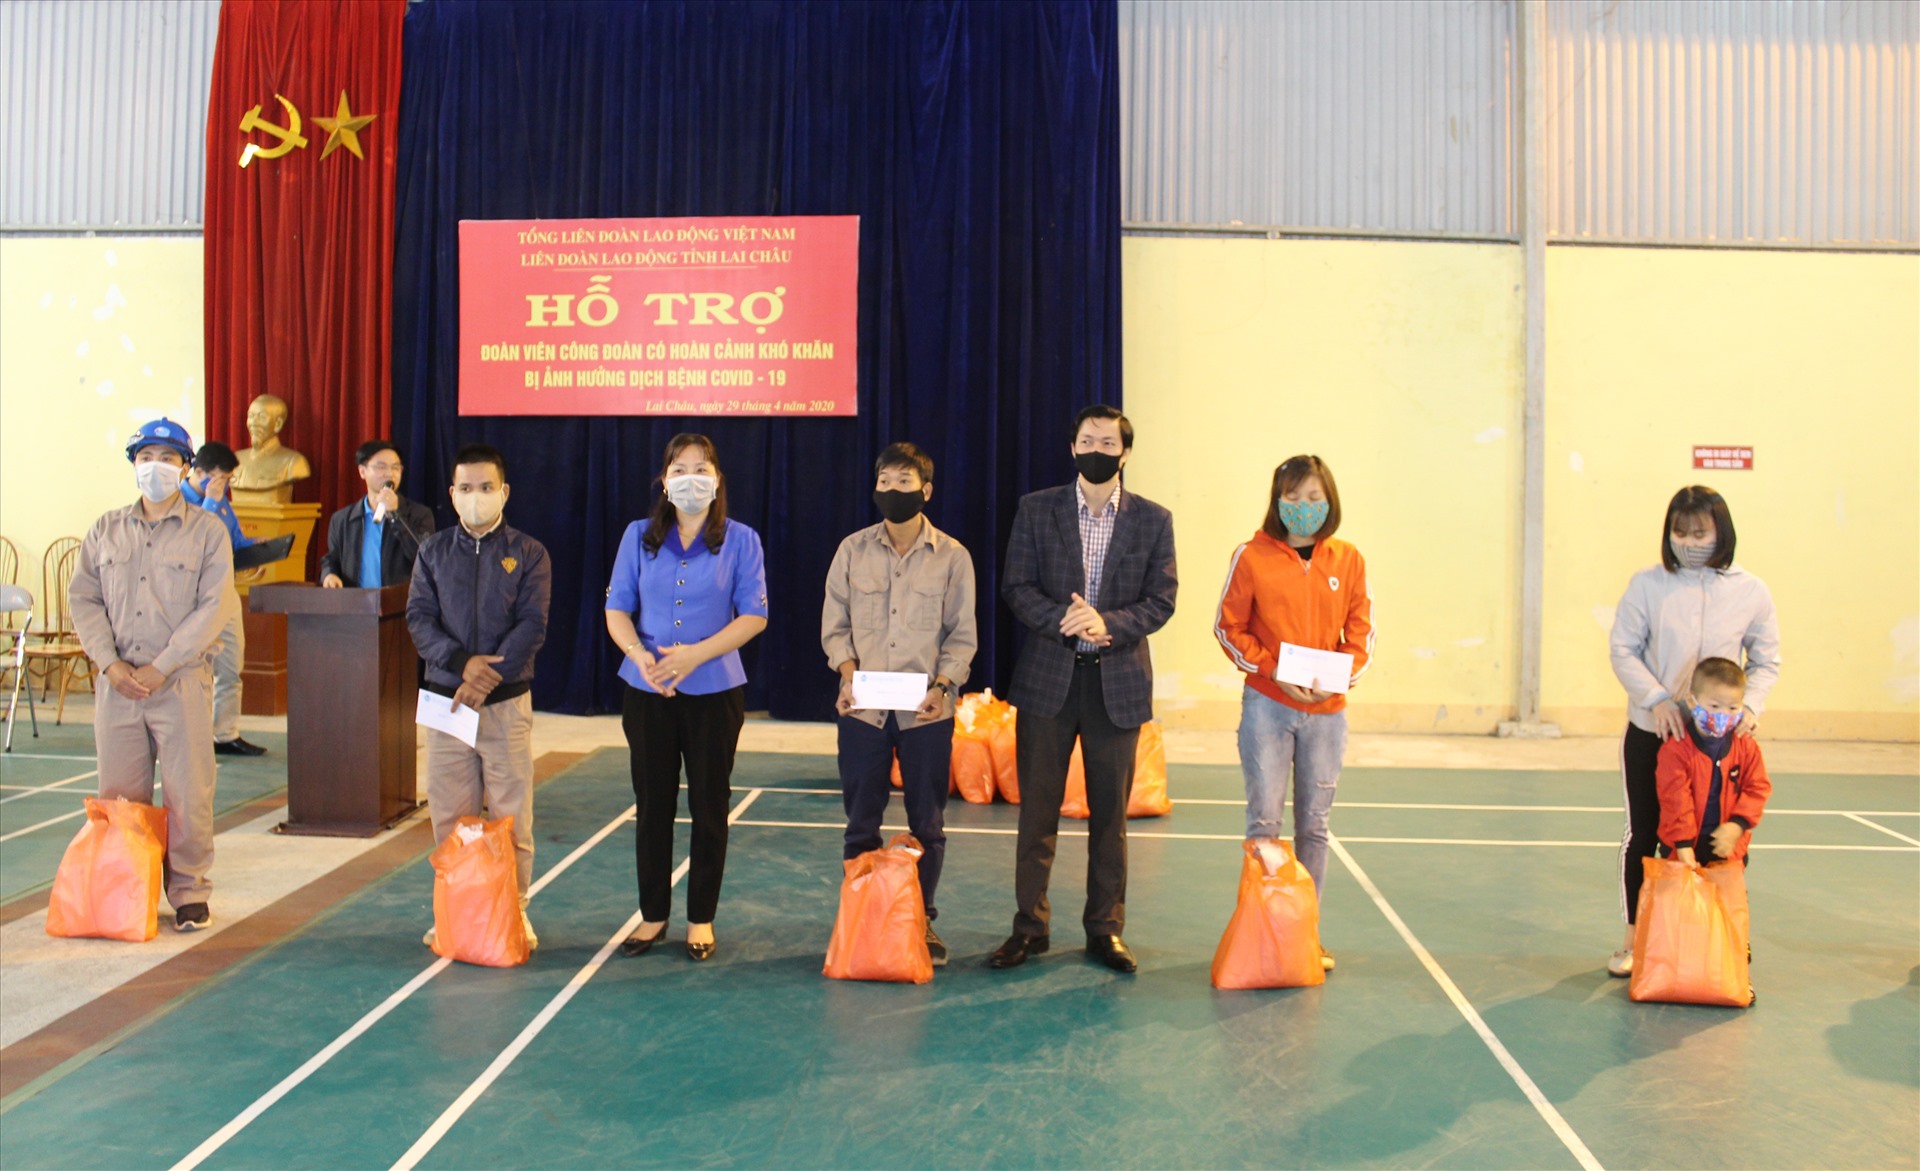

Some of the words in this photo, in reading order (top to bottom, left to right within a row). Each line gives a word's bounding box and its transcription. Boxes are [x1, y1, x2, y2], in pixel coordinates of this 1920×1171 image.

[517, 226, 558, 244] TỔNG
[561, 227, 595, 244] LIÊN
[598, 227, 639, 243] ĐOÀN
[643, 229, 674, 242] LAO
[677, 225, 719, 244] ĐỘNG
[723, 225, 758, 243] VIỆT
[761, 228, 796, 241] NAM
[521, 250, 554, 266] LIÊN
[558, 249, 598, 265] ĐOÀN
[602, 252, 632, 265] LAO
[635, 249, 677, 267] ĐỘNG
[680, 247, 717, 264] TỈNH
[721, 251, 746, 263] LAI
[749, 247, 792, 263] CHÂU
[525, 275, 619, 327] HỖ
[643, 286, 787, 335] TRỢ
[480, 341, 520, 361] ĐOÀN
[523, 341, 556, 361] VIÊN
[559, 341, 599, 360] CÔNG
[602, 340, 642, 360] ĐOÀN
[646, 340, 666, 360] CÓ
[669, 340, 710, 360] HOÀN
[714, 337, 754, 359] CẢNH
[758, 339, 789, 359] KHÓ
[792, 339, 834, 359] KHĂN
[525, 370, 539, 391] BỊ
[543, 365, 573, 387] ẢNH
[576, 365, 626, 387] HƯỞNG
[629, 370, 664, 390] DỊCH
[667, 366, 707, 390] BỆNH
[710, 369, 753, 386] COVID
[768, 369, 786, 386] 19
[645, 400, 662, 412] Lai
[665, 400, 696, 412] Châu,
[700, 400, 724, 414] ngày
[726, 400, 740, 411] 29
[741, 400, 771, 414] tháng
[773, 400, 781, 411] 4
[783, 400, 806, 412] năm
[809, 400, 835, 412] 2020
